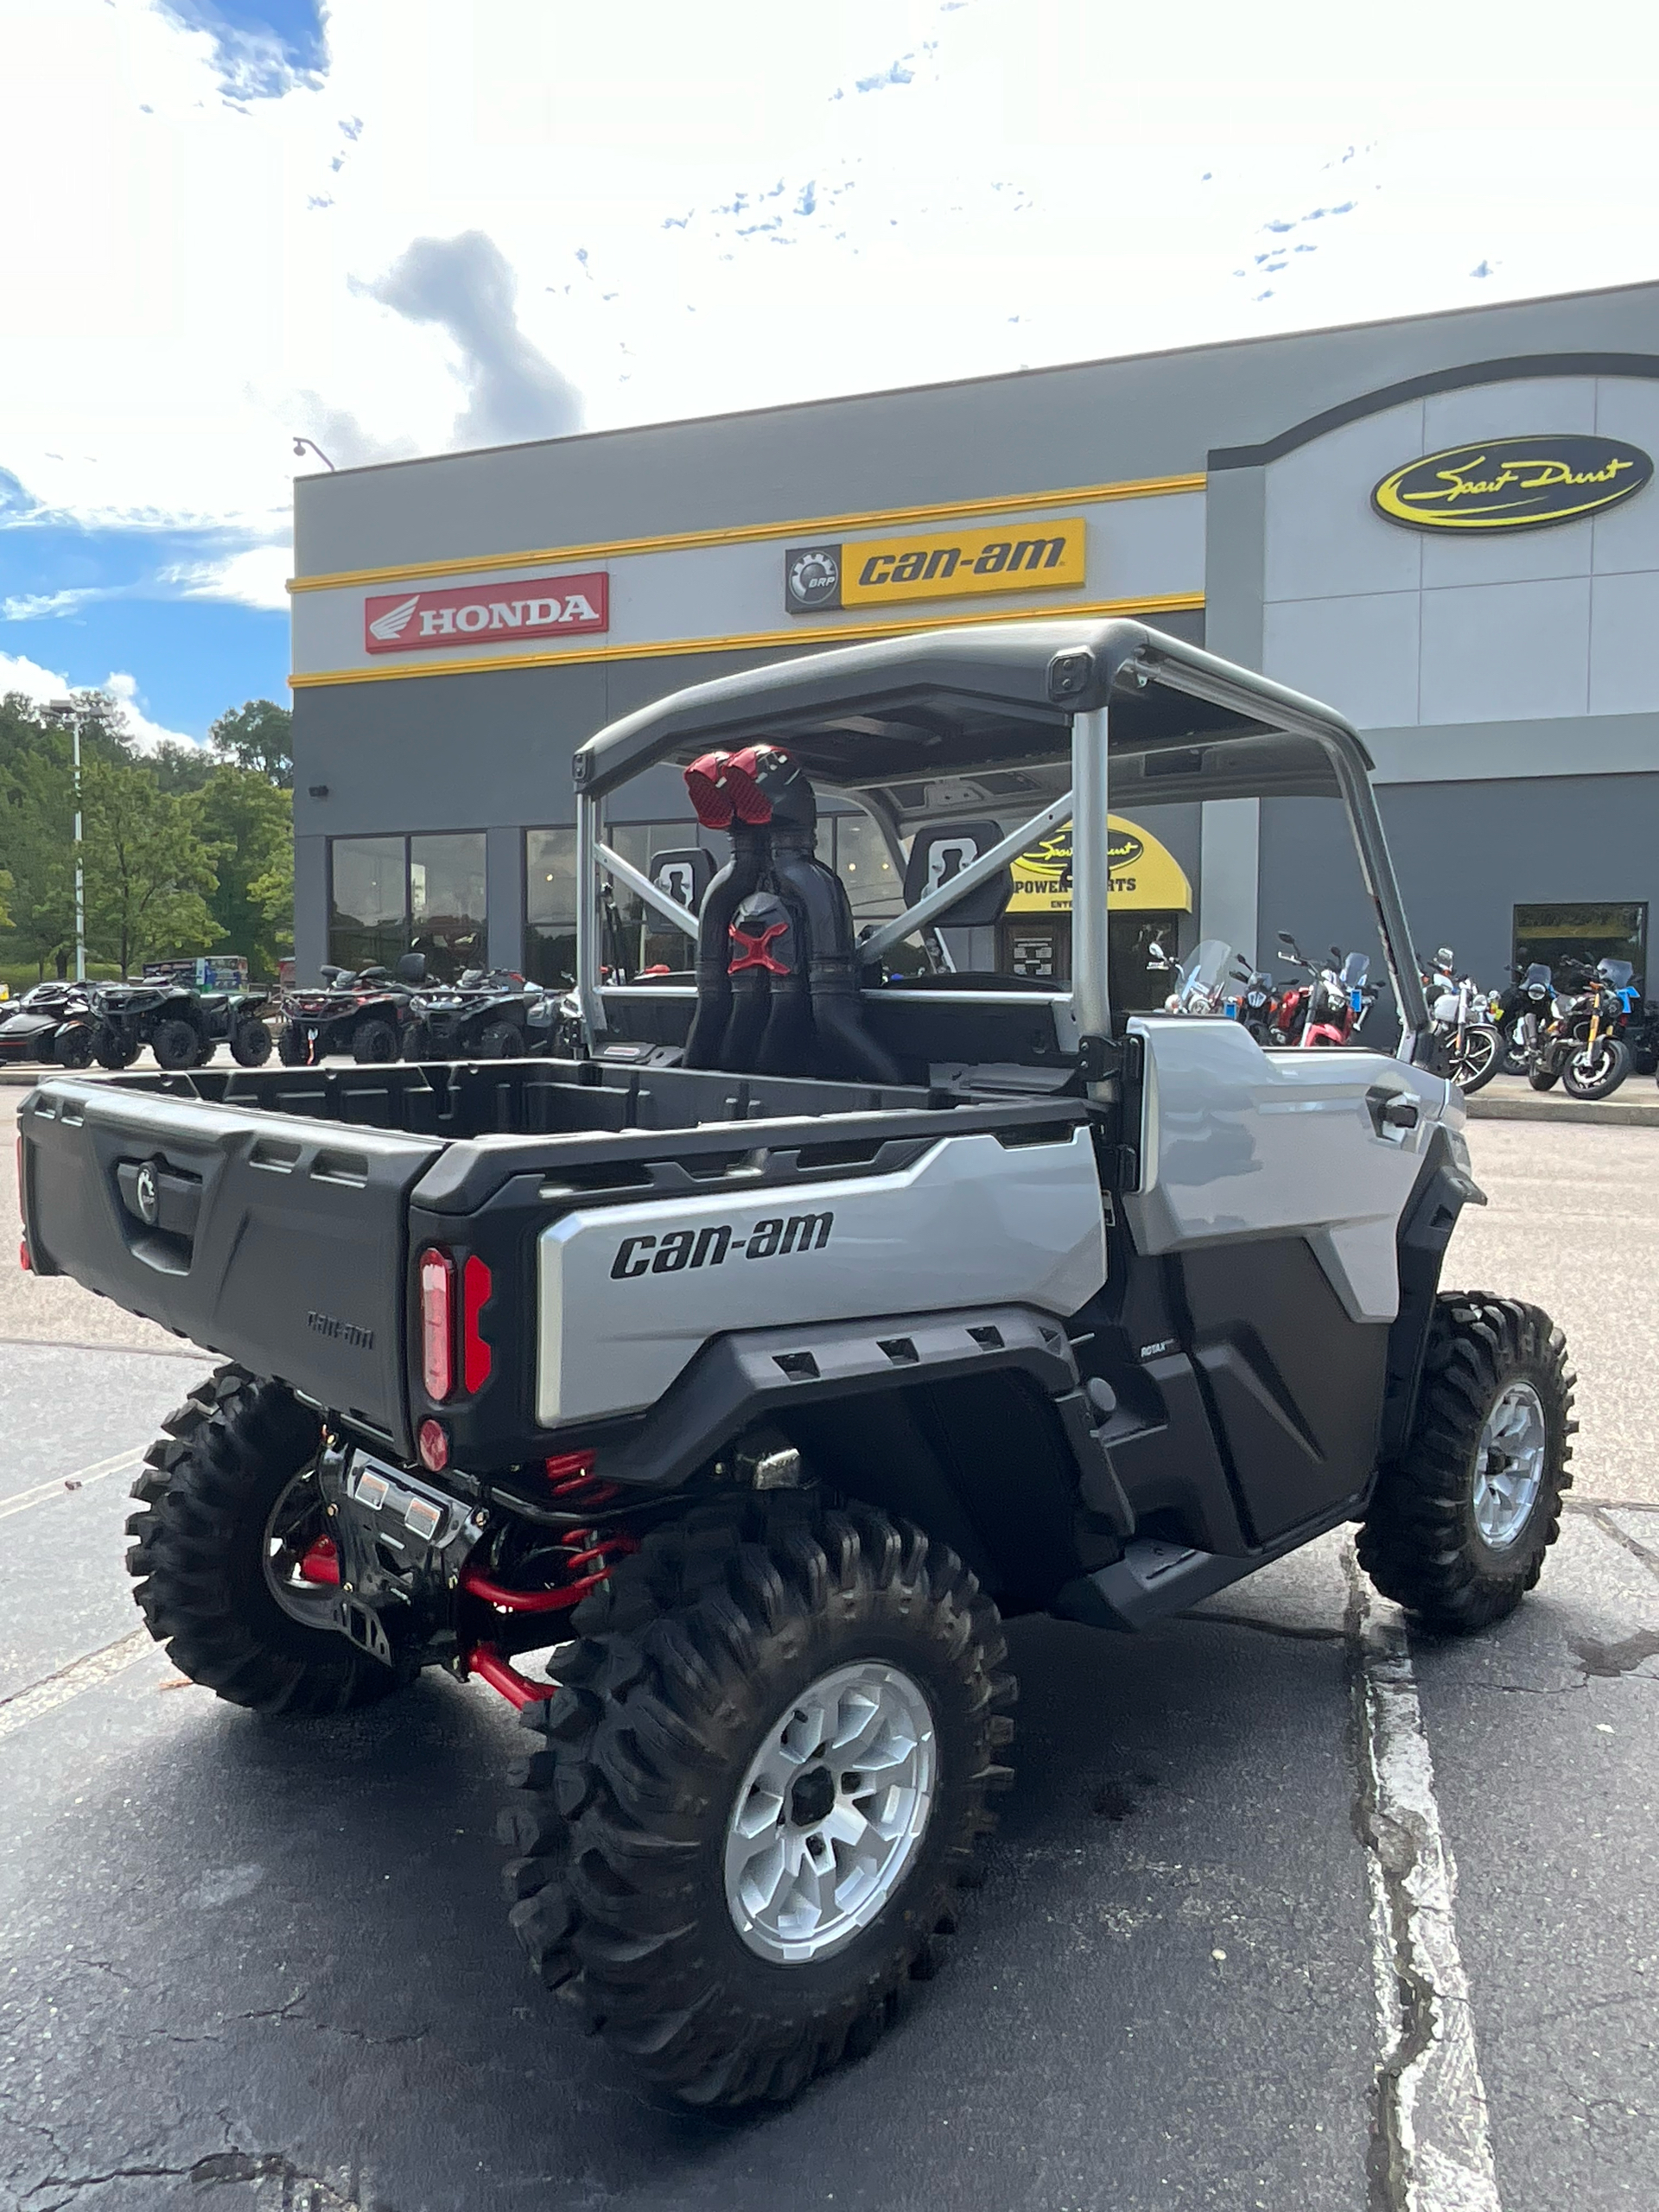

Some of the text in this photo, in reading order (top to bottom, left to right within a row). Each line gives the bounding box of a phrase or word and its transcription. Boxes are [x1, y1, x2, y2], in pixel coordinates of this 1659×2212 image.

[808, 576, 836, 588] BRP
[859, 537, 1066, 587] can-am
[419, 594, 600, 636] HONDA
[609, 1211, 835, 1280] can-am
